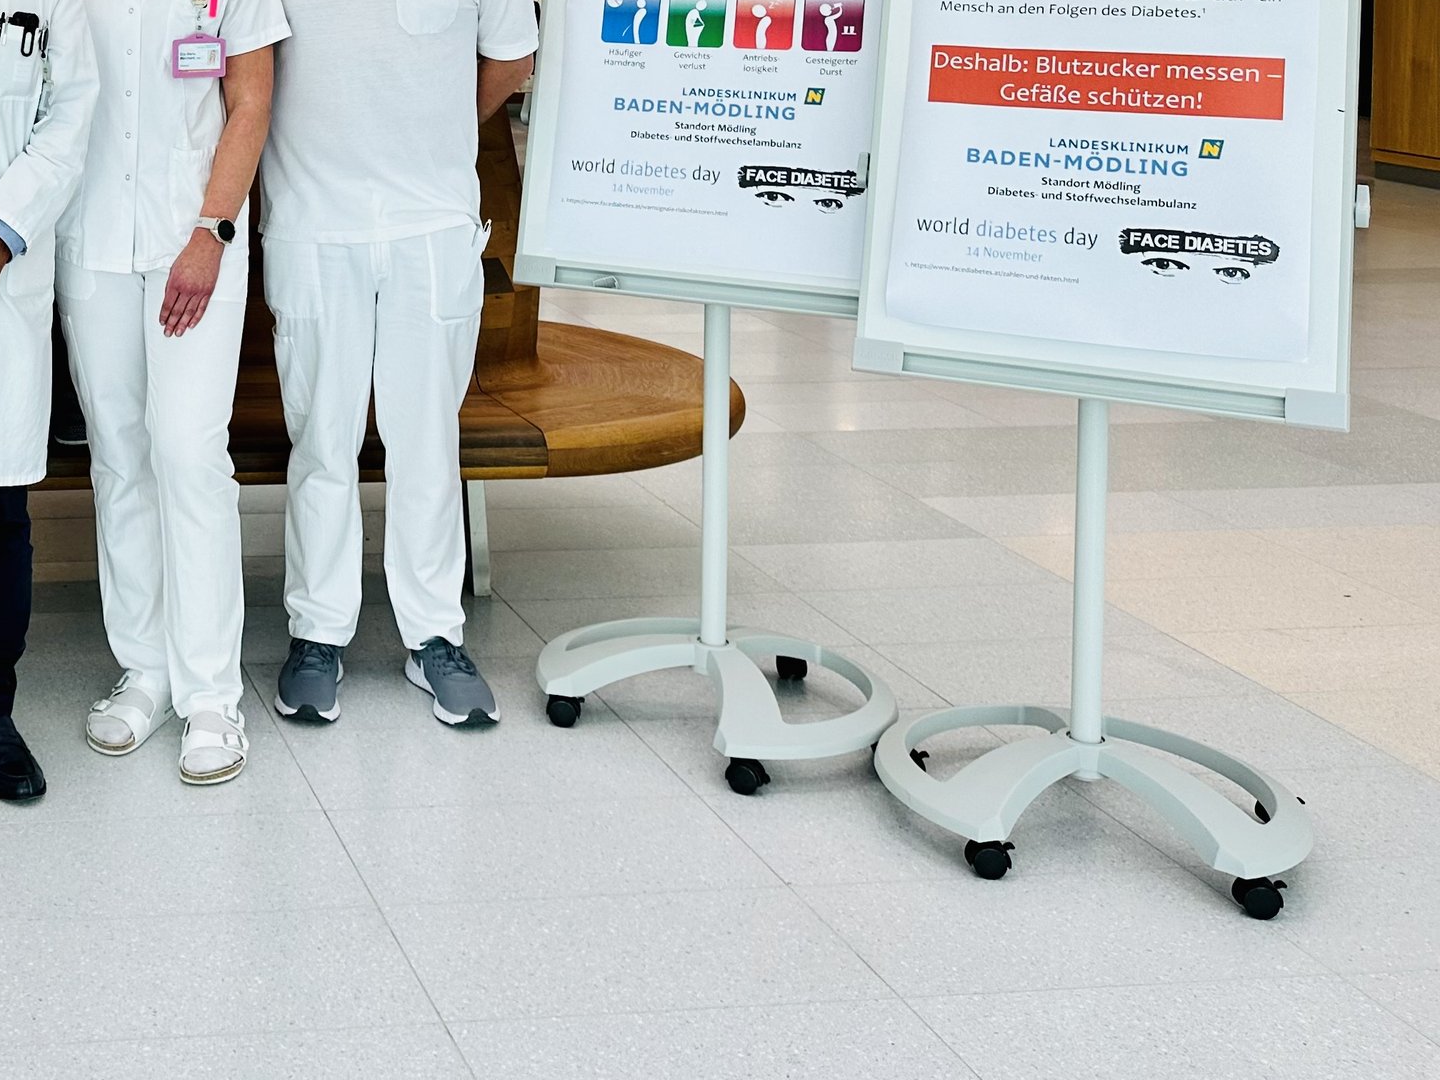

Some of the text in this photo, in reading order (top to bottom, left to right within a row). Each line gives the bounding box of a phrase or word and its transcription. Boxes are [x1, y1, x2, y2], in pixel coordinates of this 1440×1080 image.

[940, 1, 994, 14] Mensch
[997, 4, 1014, 15] an
[1018, 2, 1045, 15] den
[1049, 3, 1097, 19] Folgen
[1101, 4, 1127, 17] des
[608, 48, 642, 59] Häufiger
[805, 56, 858, 68] Gesteigerter
[603, 58, 646, 70] Harndrang
[678, 62, 706, 71] verlust
[743, 63, 778, 75] losigkeit
[819, 67, 843, 77] Durst
[934, 51, 1260, 83] Deshalb: Blutzucker messen
[682, 87, 797, 103] LANDESKLINIKUM
[1000, 83, 1203, 110] Gefäße schützen!
[613, 97, 797, 121] BADEN-MÖDLING
[674, 121, 757, 136] Standort Mödling
[630, 131, 802, 150] Diabetes- und Stoffwechselambulanz
[1049, 137, 1189, 156] LANDESKLINIKUM
[571, 158, 721, 185] world diabetes day
[966, 147, 1190, 178] BADEN-MÖDLING
[745, 168, 788, 184] FACE
[1041, 176, 1141, 194] Standort Mödling
[611, 183, 675, 197] 14 November
[987, 185, 1197, 210] Diabetes- und Stoffwechselambulanz
[916, 216, 1099, 250] world diabetes day
[1129, 231, 1272, 257] FACE DIABETES
[966, 245, 1044, 263] 14 November
